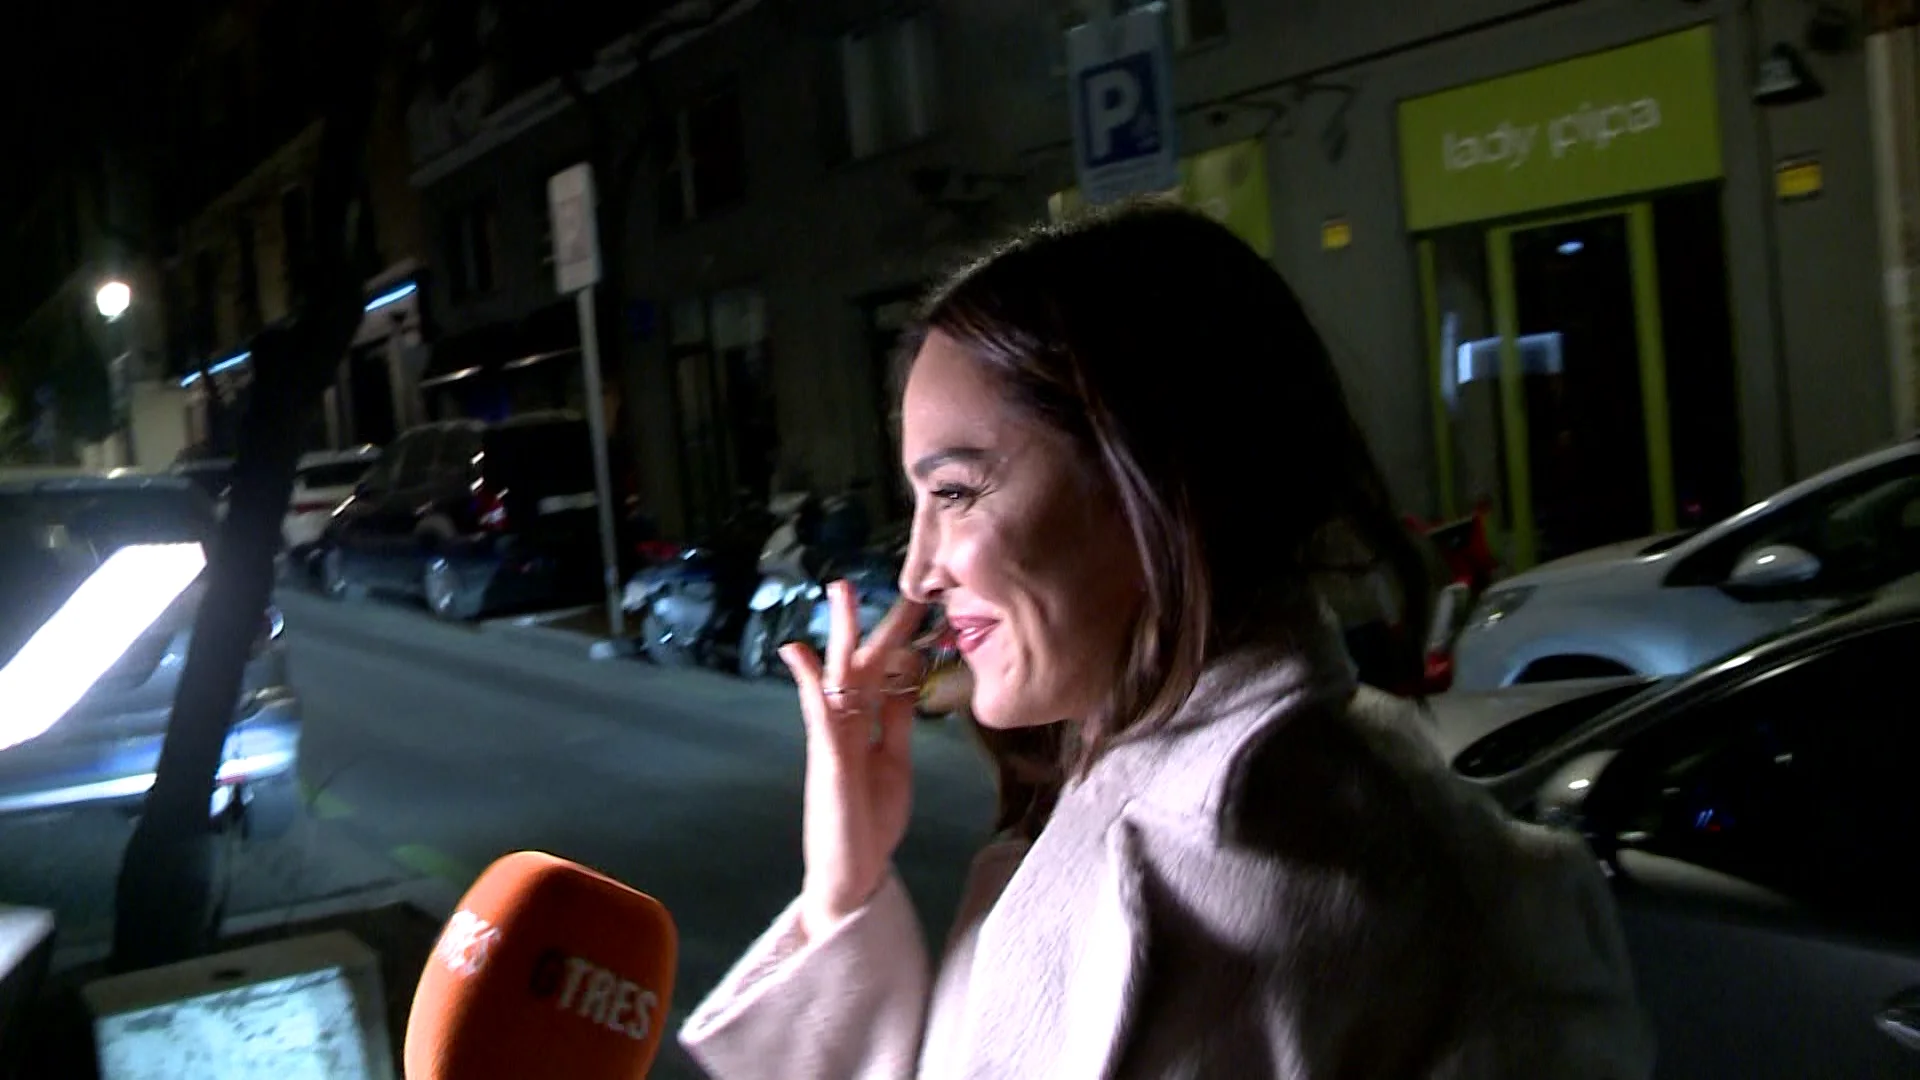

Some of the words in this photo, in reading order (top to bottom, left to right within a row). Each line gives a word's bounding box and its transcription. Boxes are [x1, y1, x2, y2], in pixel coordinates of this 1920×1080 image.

[1085, 67, 1143, 159] P
[1441, 119, 1540, 172] lady
[1547, 96, 1662, 159] pipa
